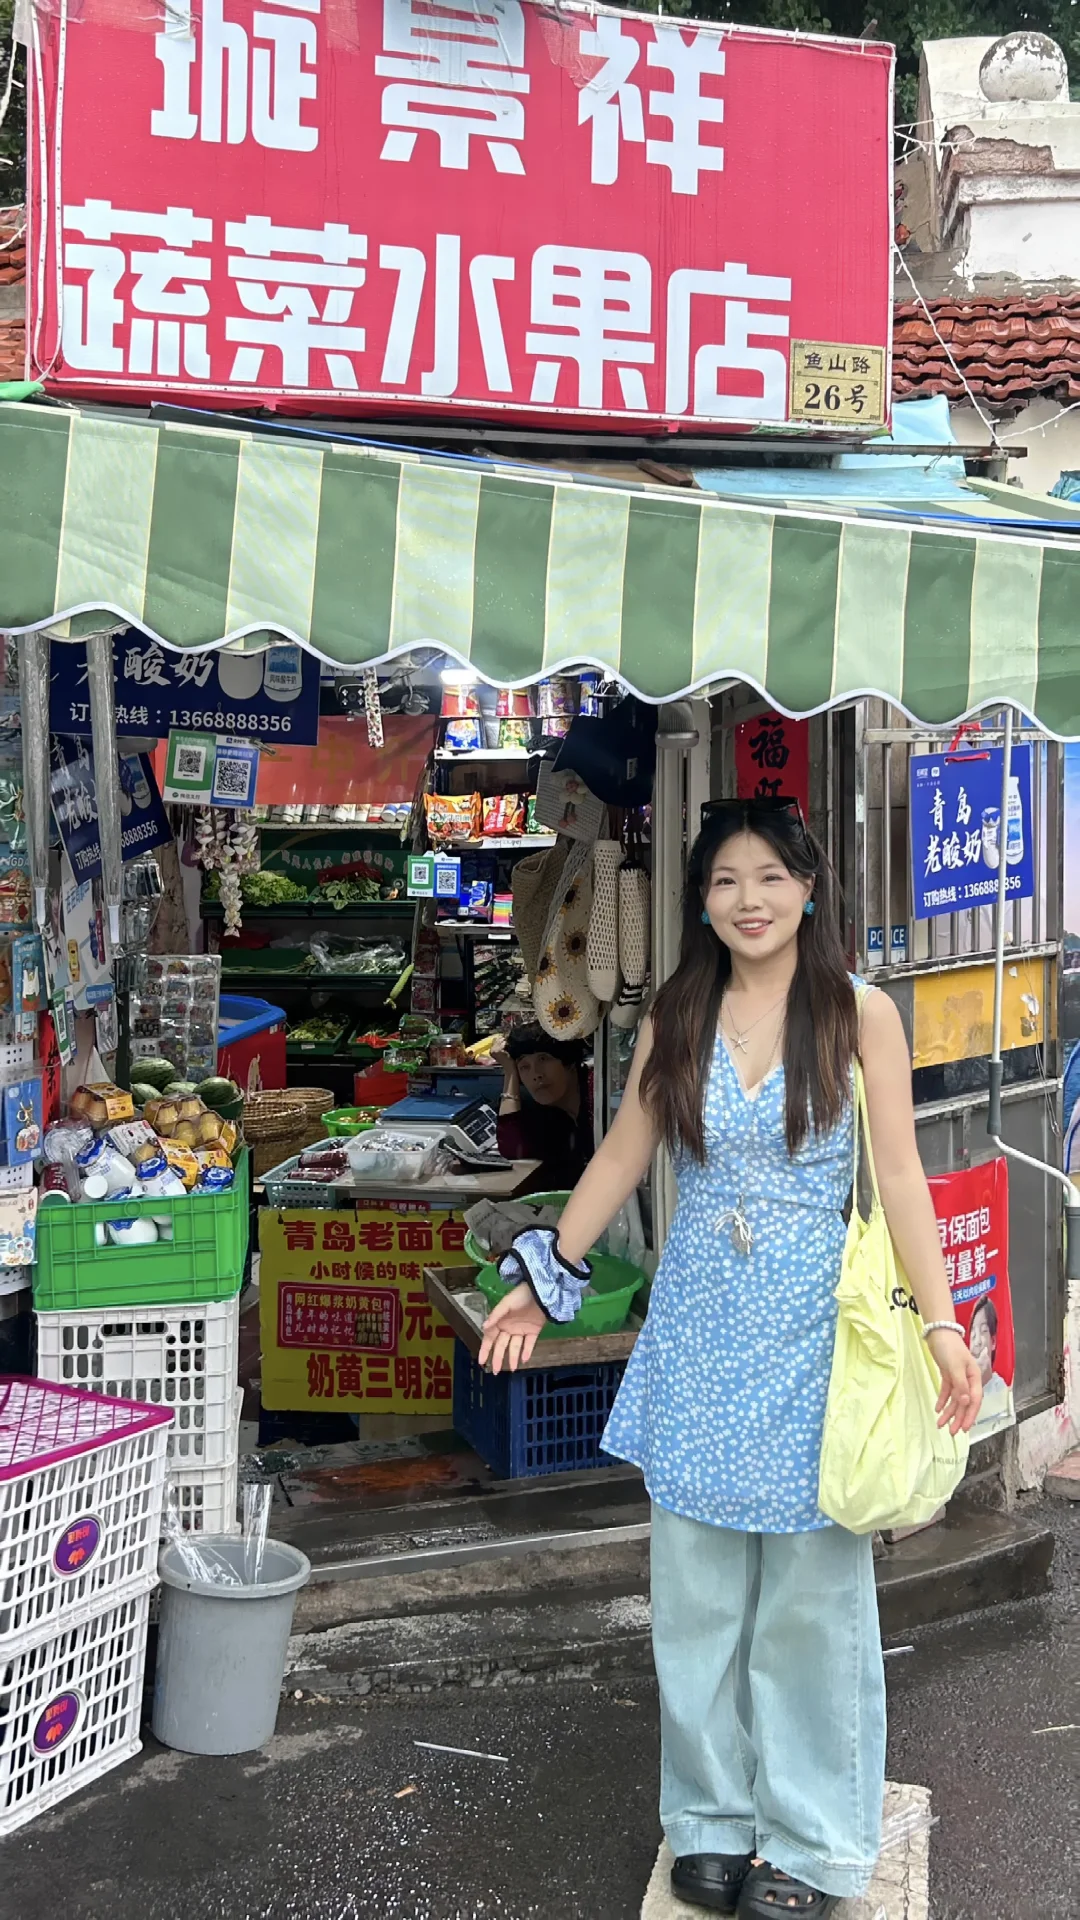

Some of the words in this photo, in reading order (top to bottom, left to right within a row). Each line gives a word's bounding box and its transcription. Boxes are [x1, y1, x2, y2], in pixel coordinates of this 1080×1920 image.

[62, 198, 792, 420] 蔬菜水果店
[803, 352, 871, 374] 鱼山路
[804, 383, 868, 414] 26号
[75, 644, 215, 688] 酸奶
[69, 702, 292, 733] 订热线：13668888356
[61, 779, 98, 835] 老酸
[928, 787, 973, 831] 青岛
[923, 829, 982, 879] 老酸奶
[923, 876, 1021, 907] 订购热线：1366888356
[870, 928, 905, 946] POICE
[283, 1220, 468, 1252] 青岛老面包
[309, 1260, 443, 1281] 小时候的味
[294, 1292, 383, 1311] 网红爆浆奶黄包
[295, 1307, 355, 1324] 童年的味道
[294, 1323, 355, 1337] 儿时的记忆
[306, 1352, 452, 1400] 奶黄三明治
